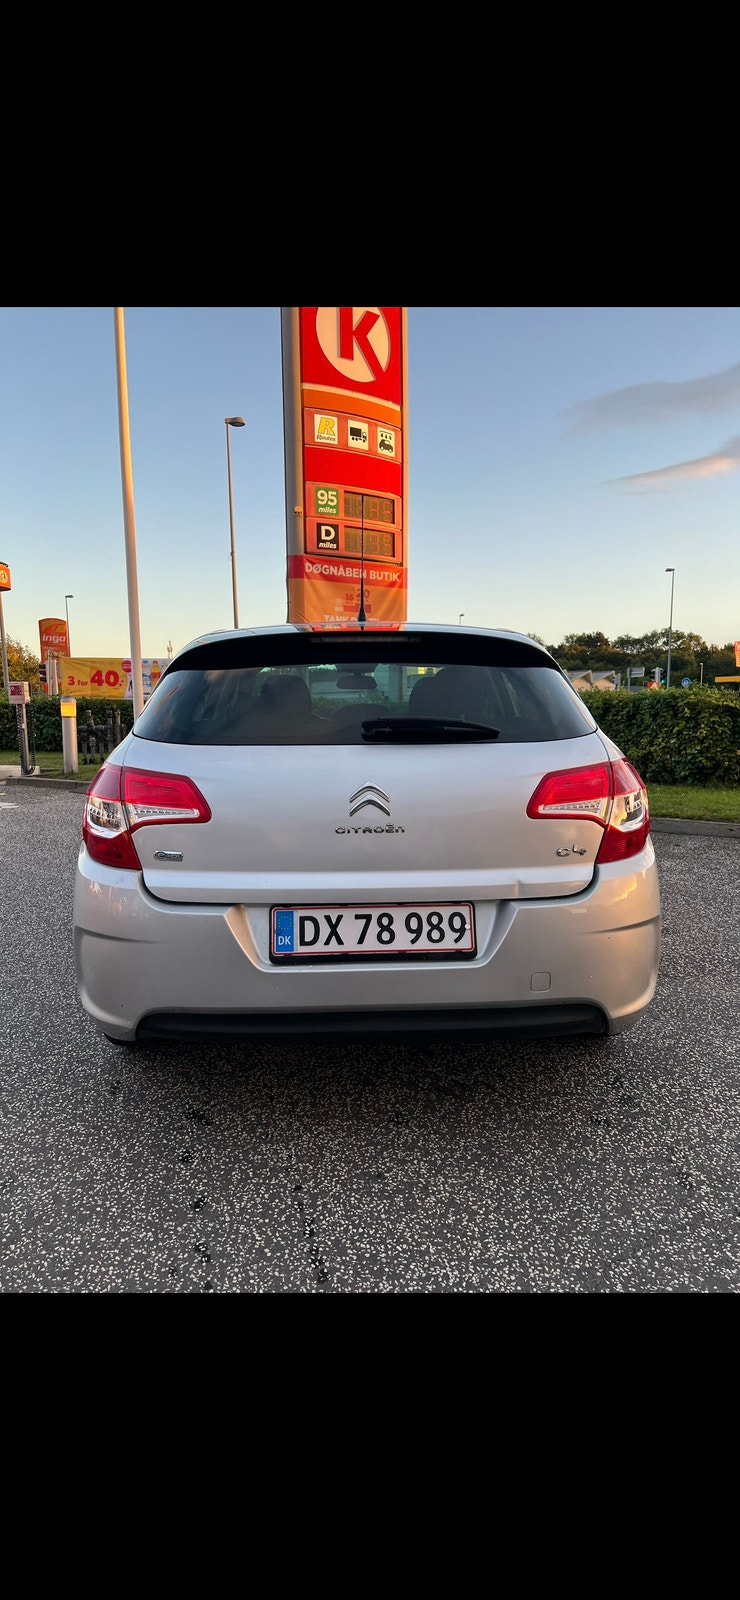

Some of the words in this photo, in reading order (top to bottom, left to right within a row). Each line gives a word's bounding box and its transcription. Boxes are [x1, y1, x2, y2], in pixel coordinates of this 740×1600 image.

[339, 307, 384, 381] K
[317, 490, 338, 506] 95
[321, 526, 336, 540] D
[305, 562, 367, 578] DØGNÅBEN
[370, 571, 399, 582] BUTIK
[42, 634, 66, 643] ingo
[67, 676, 75, 686] 3
[299, 914, 344, 946] DX
[354, 912, 396, 945] 78
[404, 911, 467, 945] 989
[278, 936, 292, 946] DK
